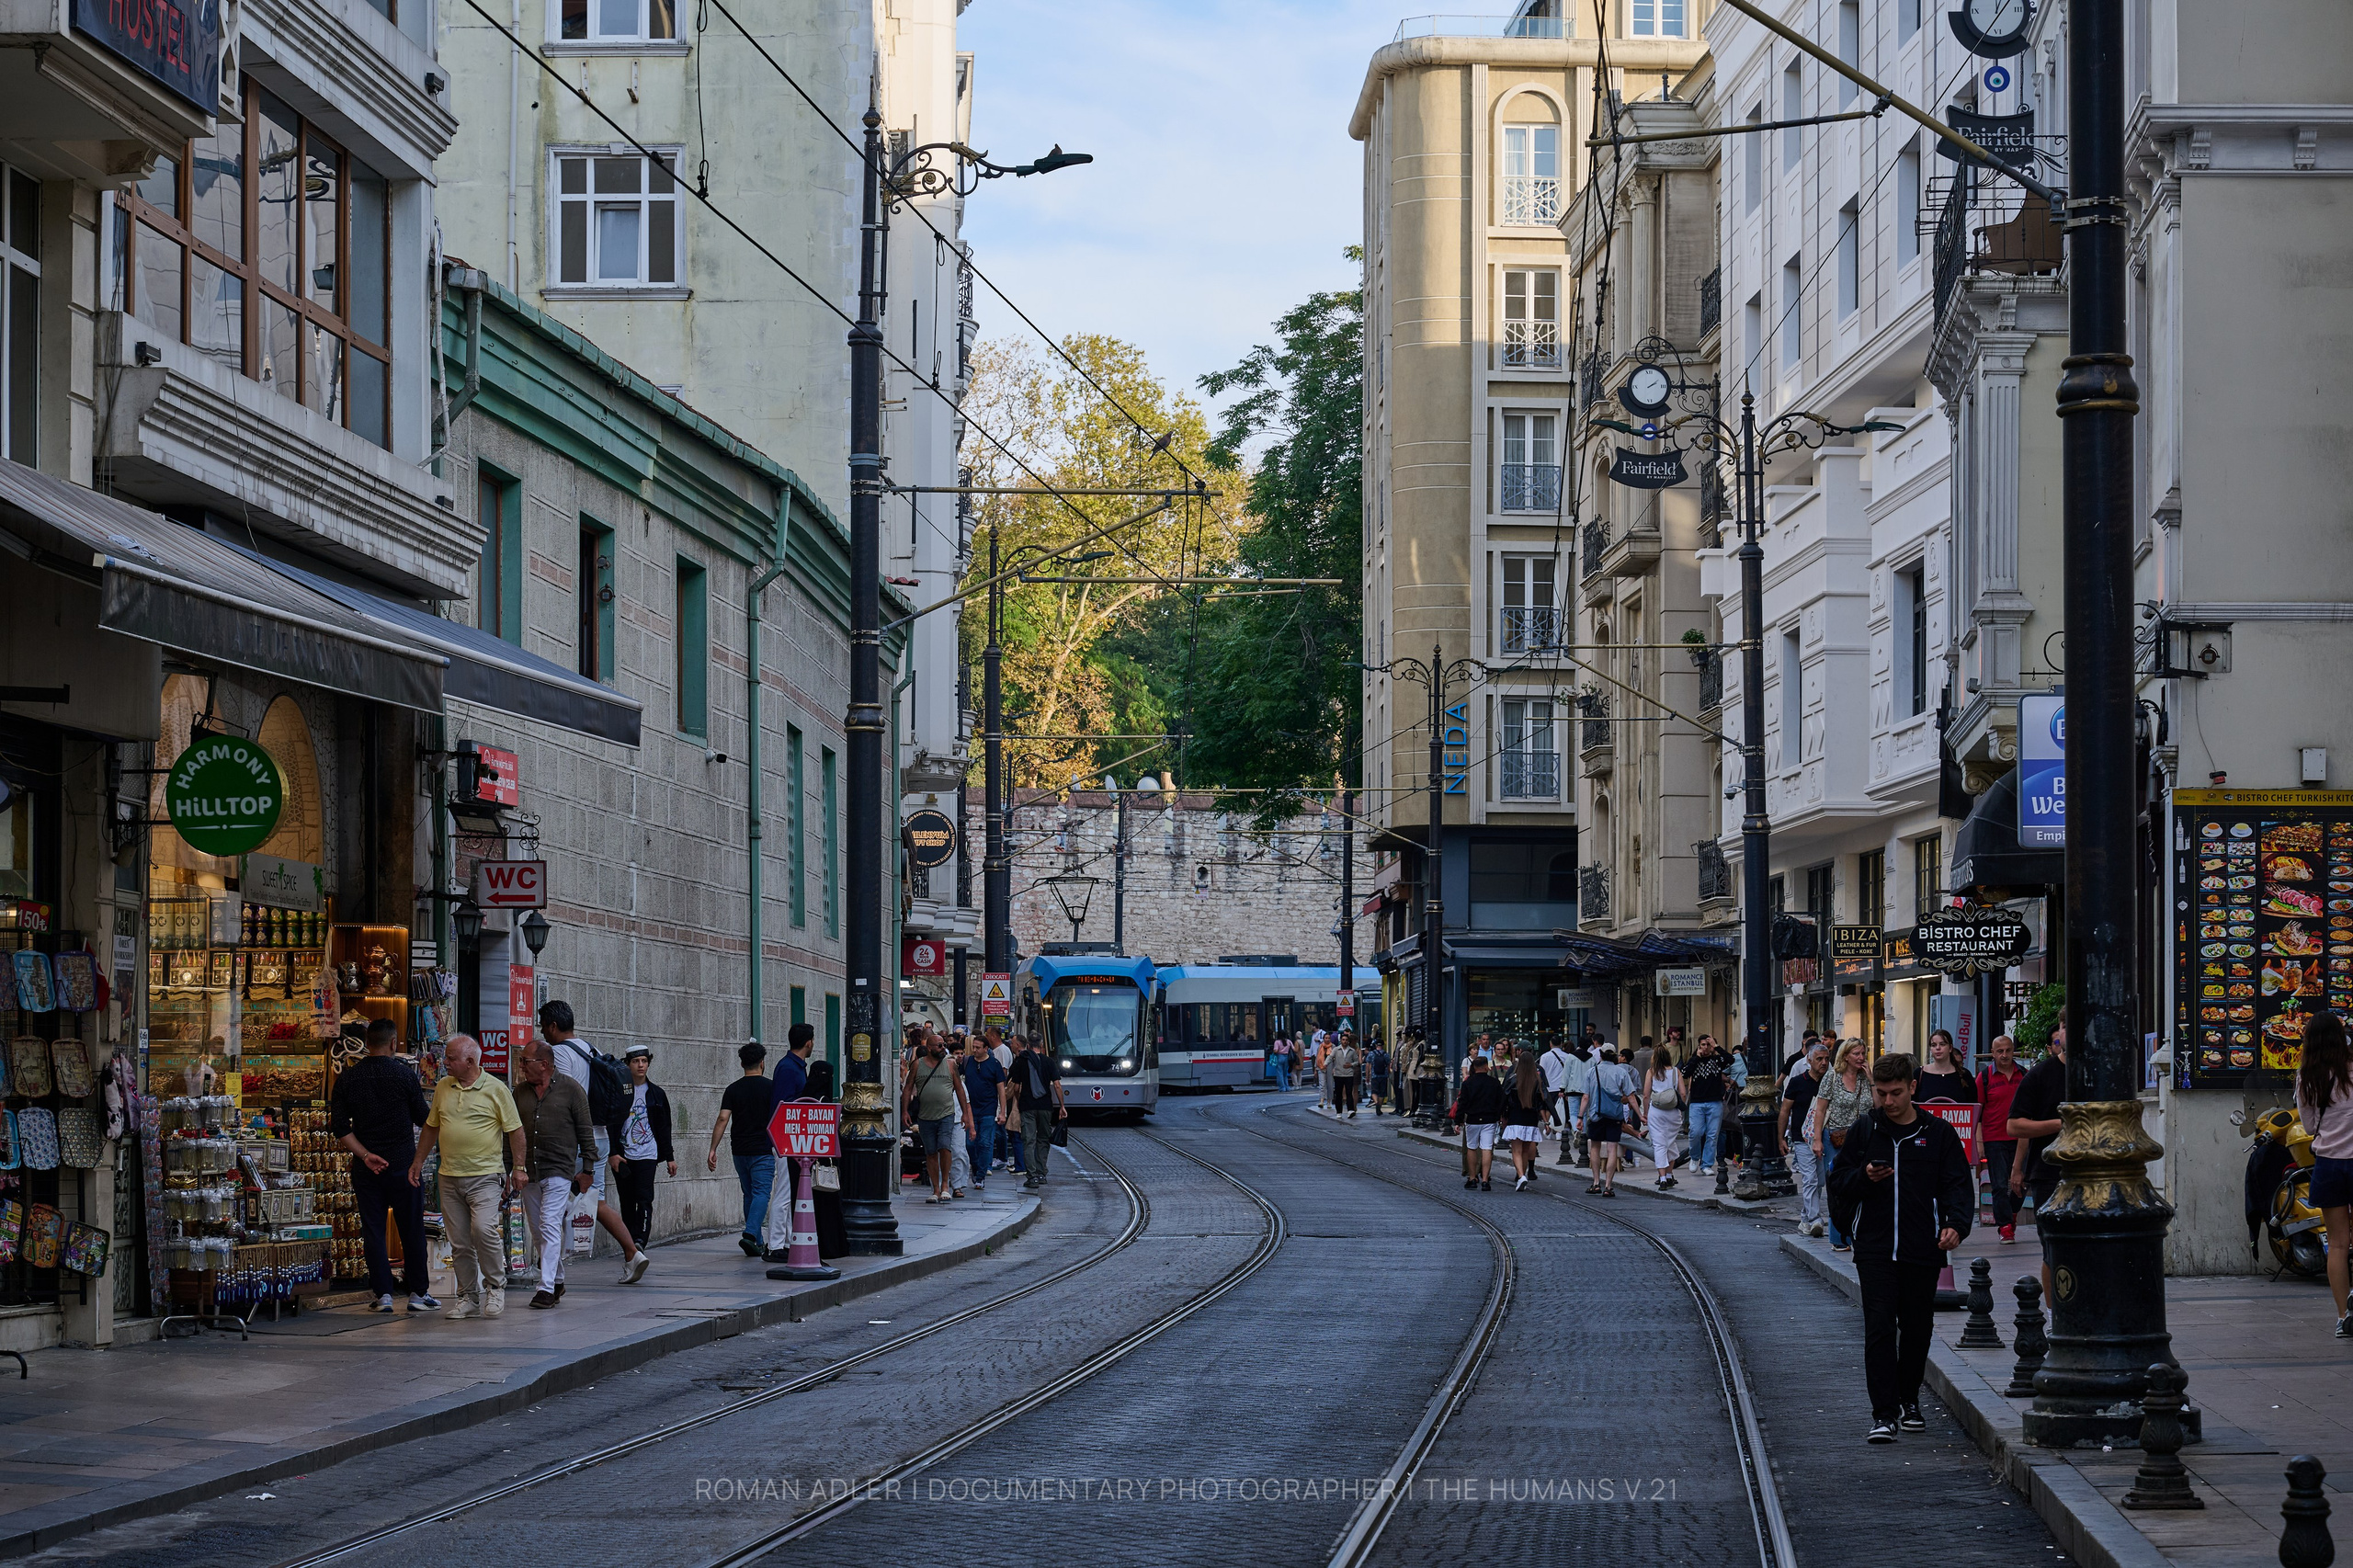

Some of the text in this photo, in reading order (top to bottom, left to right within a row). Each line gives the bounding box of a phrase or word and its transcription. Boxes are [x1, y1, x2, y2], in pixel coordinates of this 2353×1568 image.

[1621, 461, 1677, 475] Fairfield
[1444, 703, 1467, 794] NEDA
[176, 744, 271, 790] HARMONY
[2036, 831, 2065, 843] Empi
[262, 870, 297, 892] SWEET SPICE
[485, 867, 537, 889] WC
[1834, 930, 1878, 941] IBIZA
[1919, 926, 2021, 939] BİSTRO CHEF
[1927, 940, 2014, 952] RESTAURANT
[1959, 1014, 1971, 1035] Bull
[482, 1032, 507, 1047] WC
[786, 1108, 801, 1120] BAY
[808, 1109, 834, 1121] BAYAN
[785, 1123, 800, 1134] MEN
[807, 1124, 835, 1134] WOMAN
[1954, 1127, 1971, 1139] MAN
[790, 1135, 830, 1153] WC
